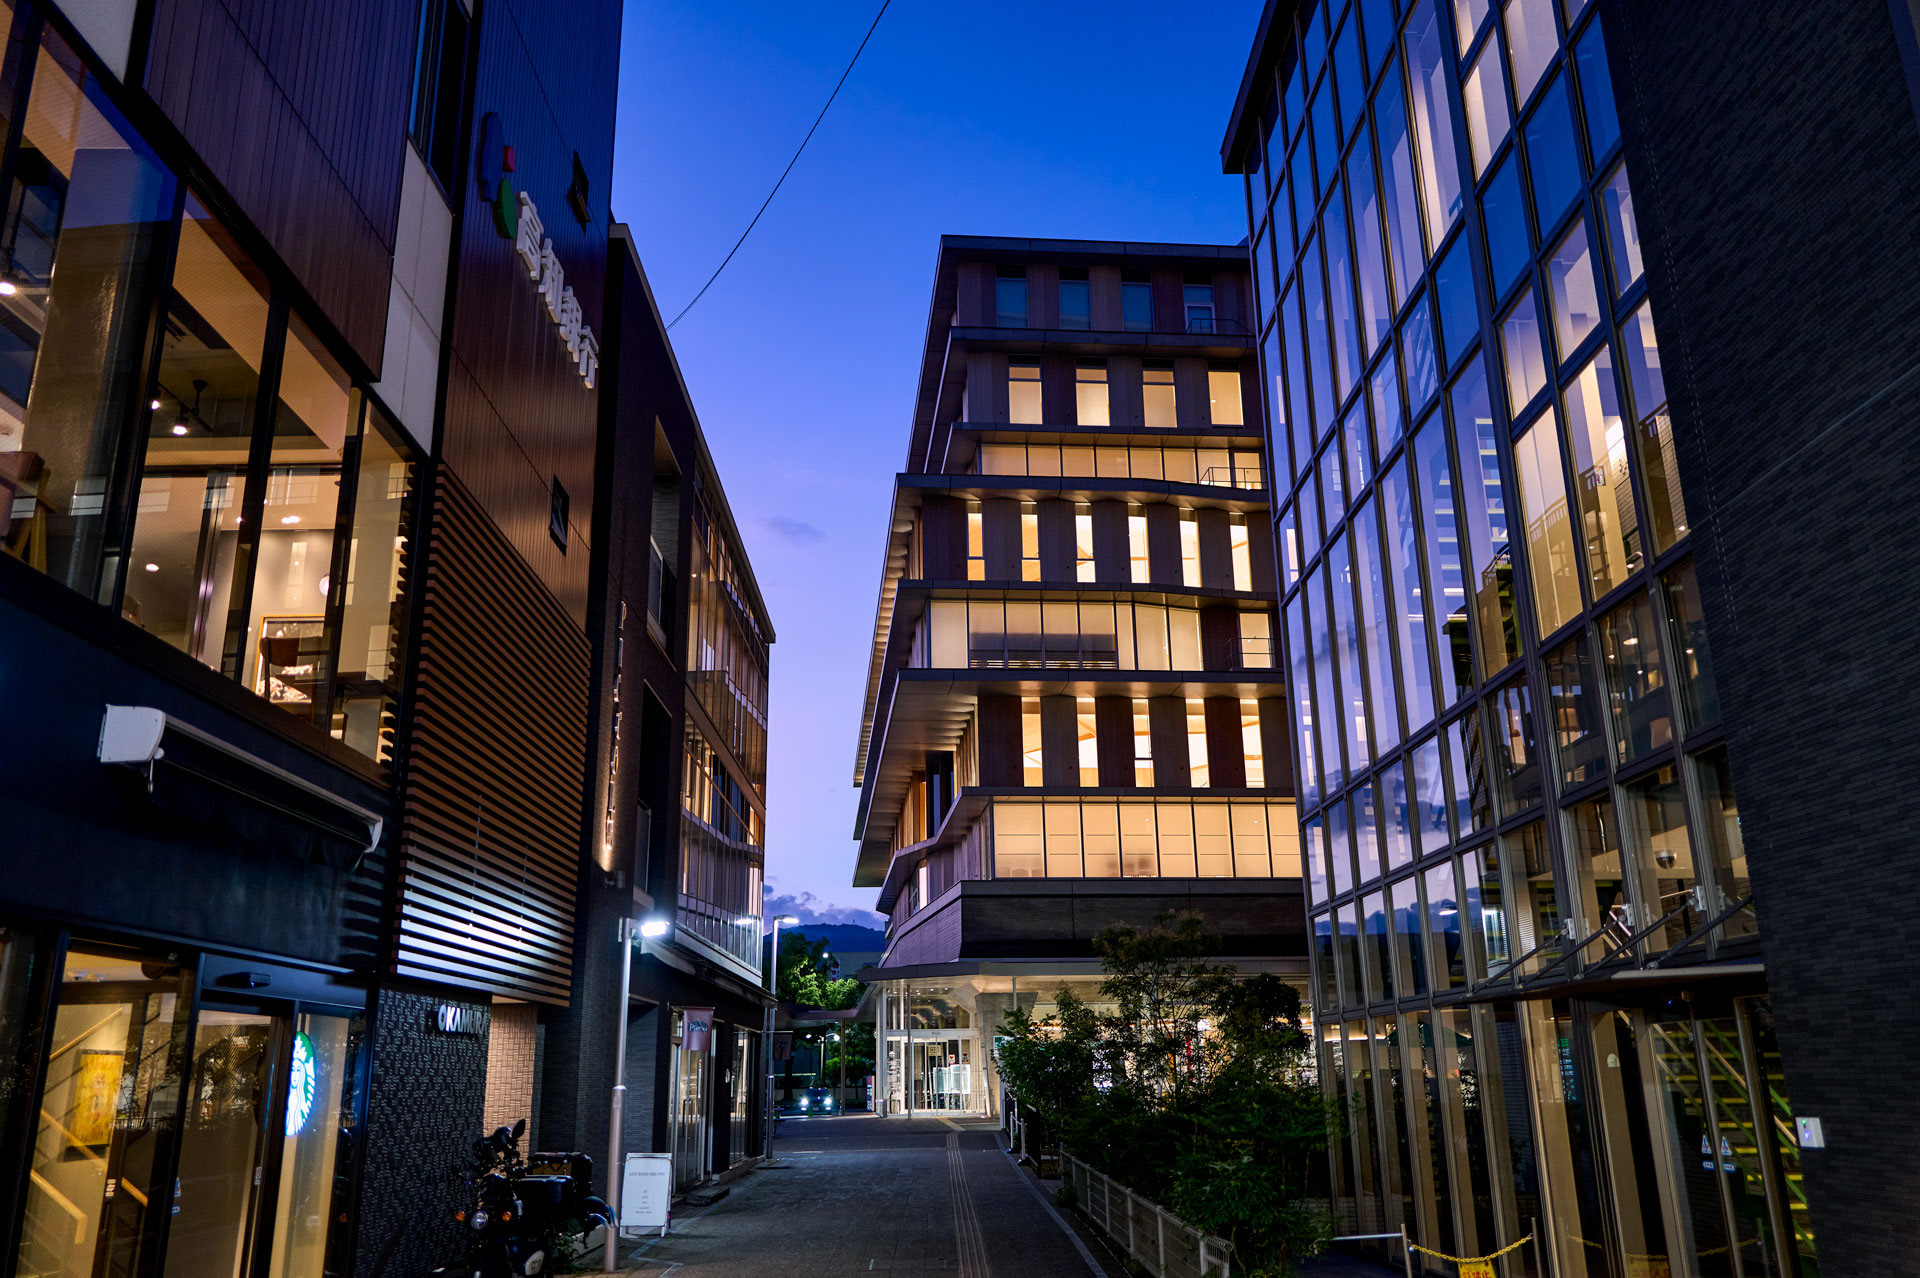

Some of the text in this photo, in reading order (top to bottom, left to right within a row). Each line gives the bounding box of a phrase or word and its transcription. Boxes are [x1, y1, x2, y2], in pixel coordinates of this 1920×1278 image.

[516, 191, 599, 389] 高知銀行
[437, 1004, 489, 1036] OKAMURA
